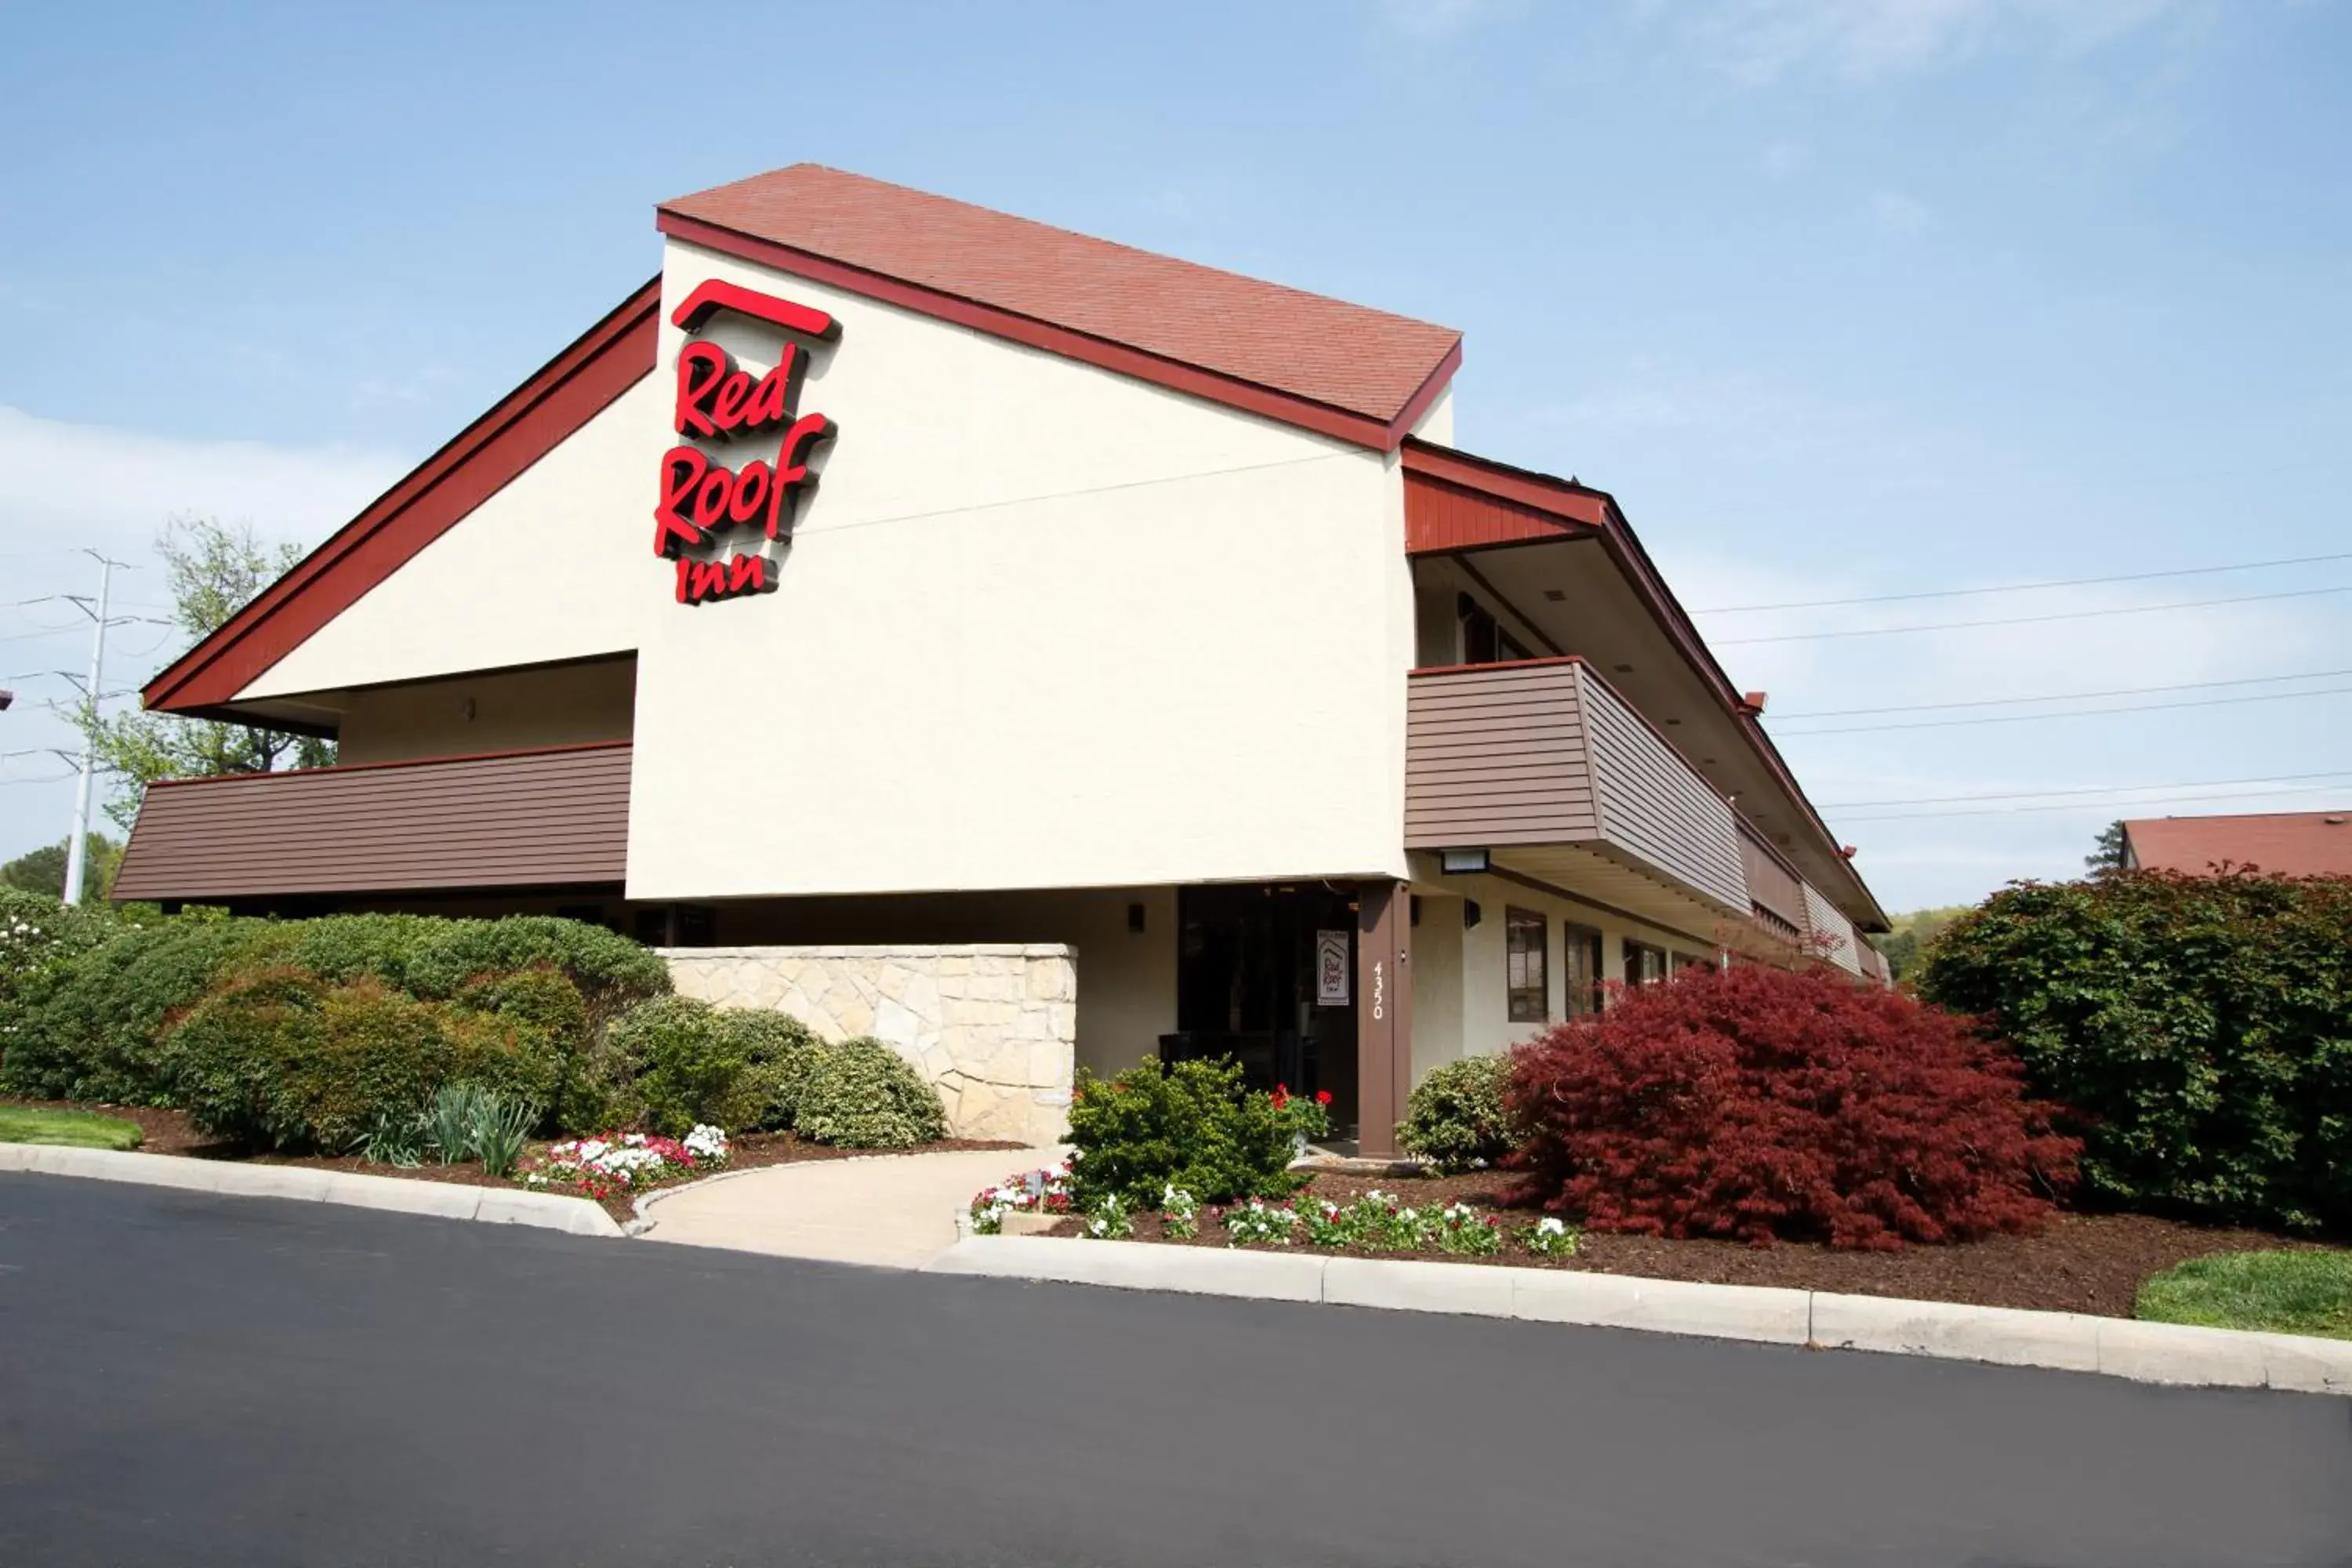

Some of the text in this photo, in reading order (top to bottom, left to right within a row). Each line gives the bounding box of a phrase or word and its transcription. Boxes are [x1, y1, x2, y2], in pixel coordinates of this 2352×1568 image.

[675, 341, 797, 437] Red
[654, 412, 828, 557] Roof
[1374, 961, 1383, 1019] 4350
